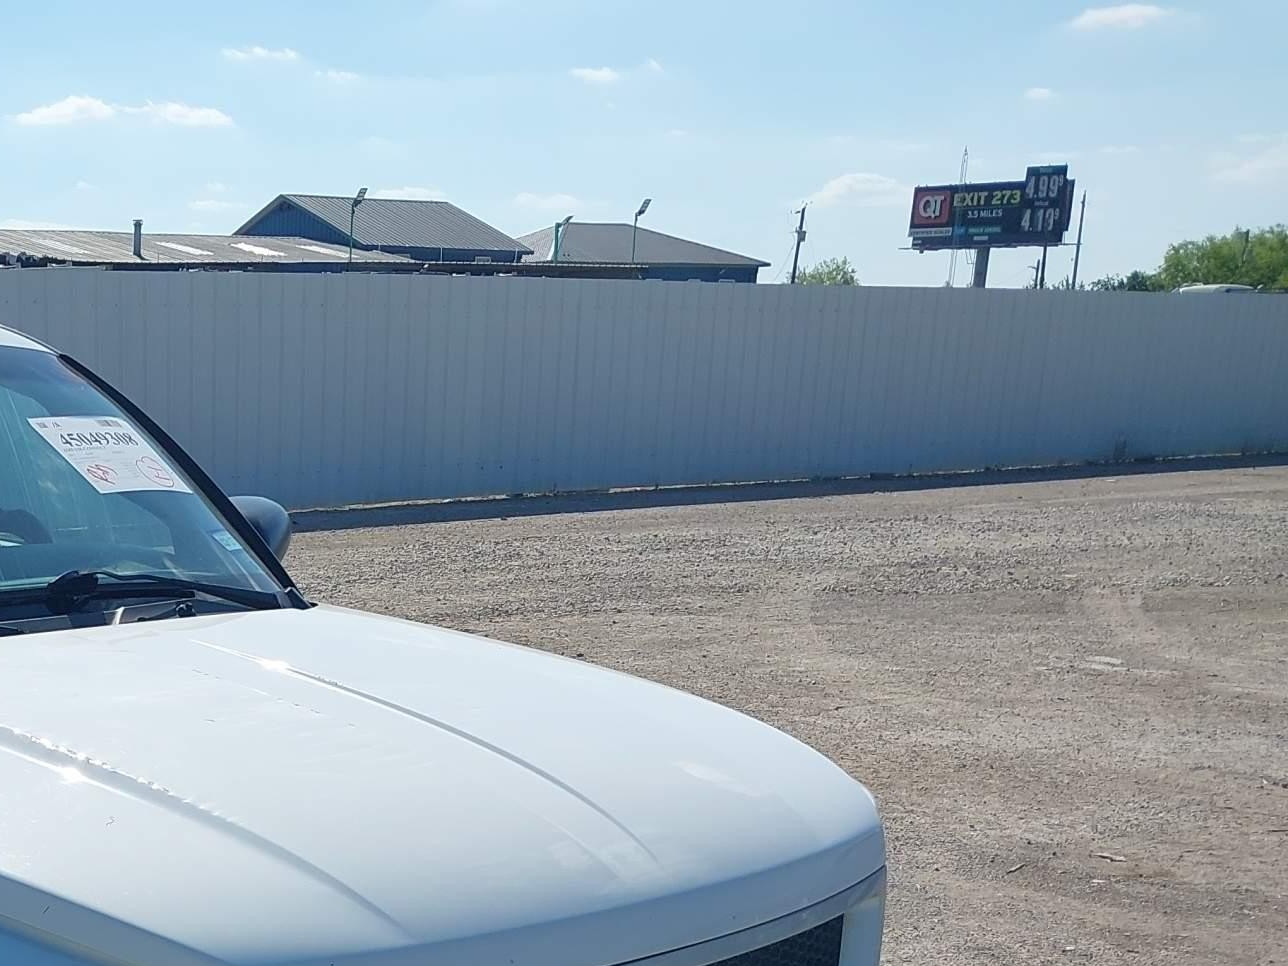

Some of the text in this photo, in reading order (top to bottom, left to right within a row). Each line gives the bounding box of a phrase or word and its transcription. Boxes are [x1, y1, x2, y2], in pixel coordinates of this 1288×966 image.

[953, 191, 989, 207] EXIT
[991, 189, 1022, 206] 273
[918, 195, 945, 219] QT
[979, 208, 1003, 217] MILES
[59, 432, 138, 446] 45049308
